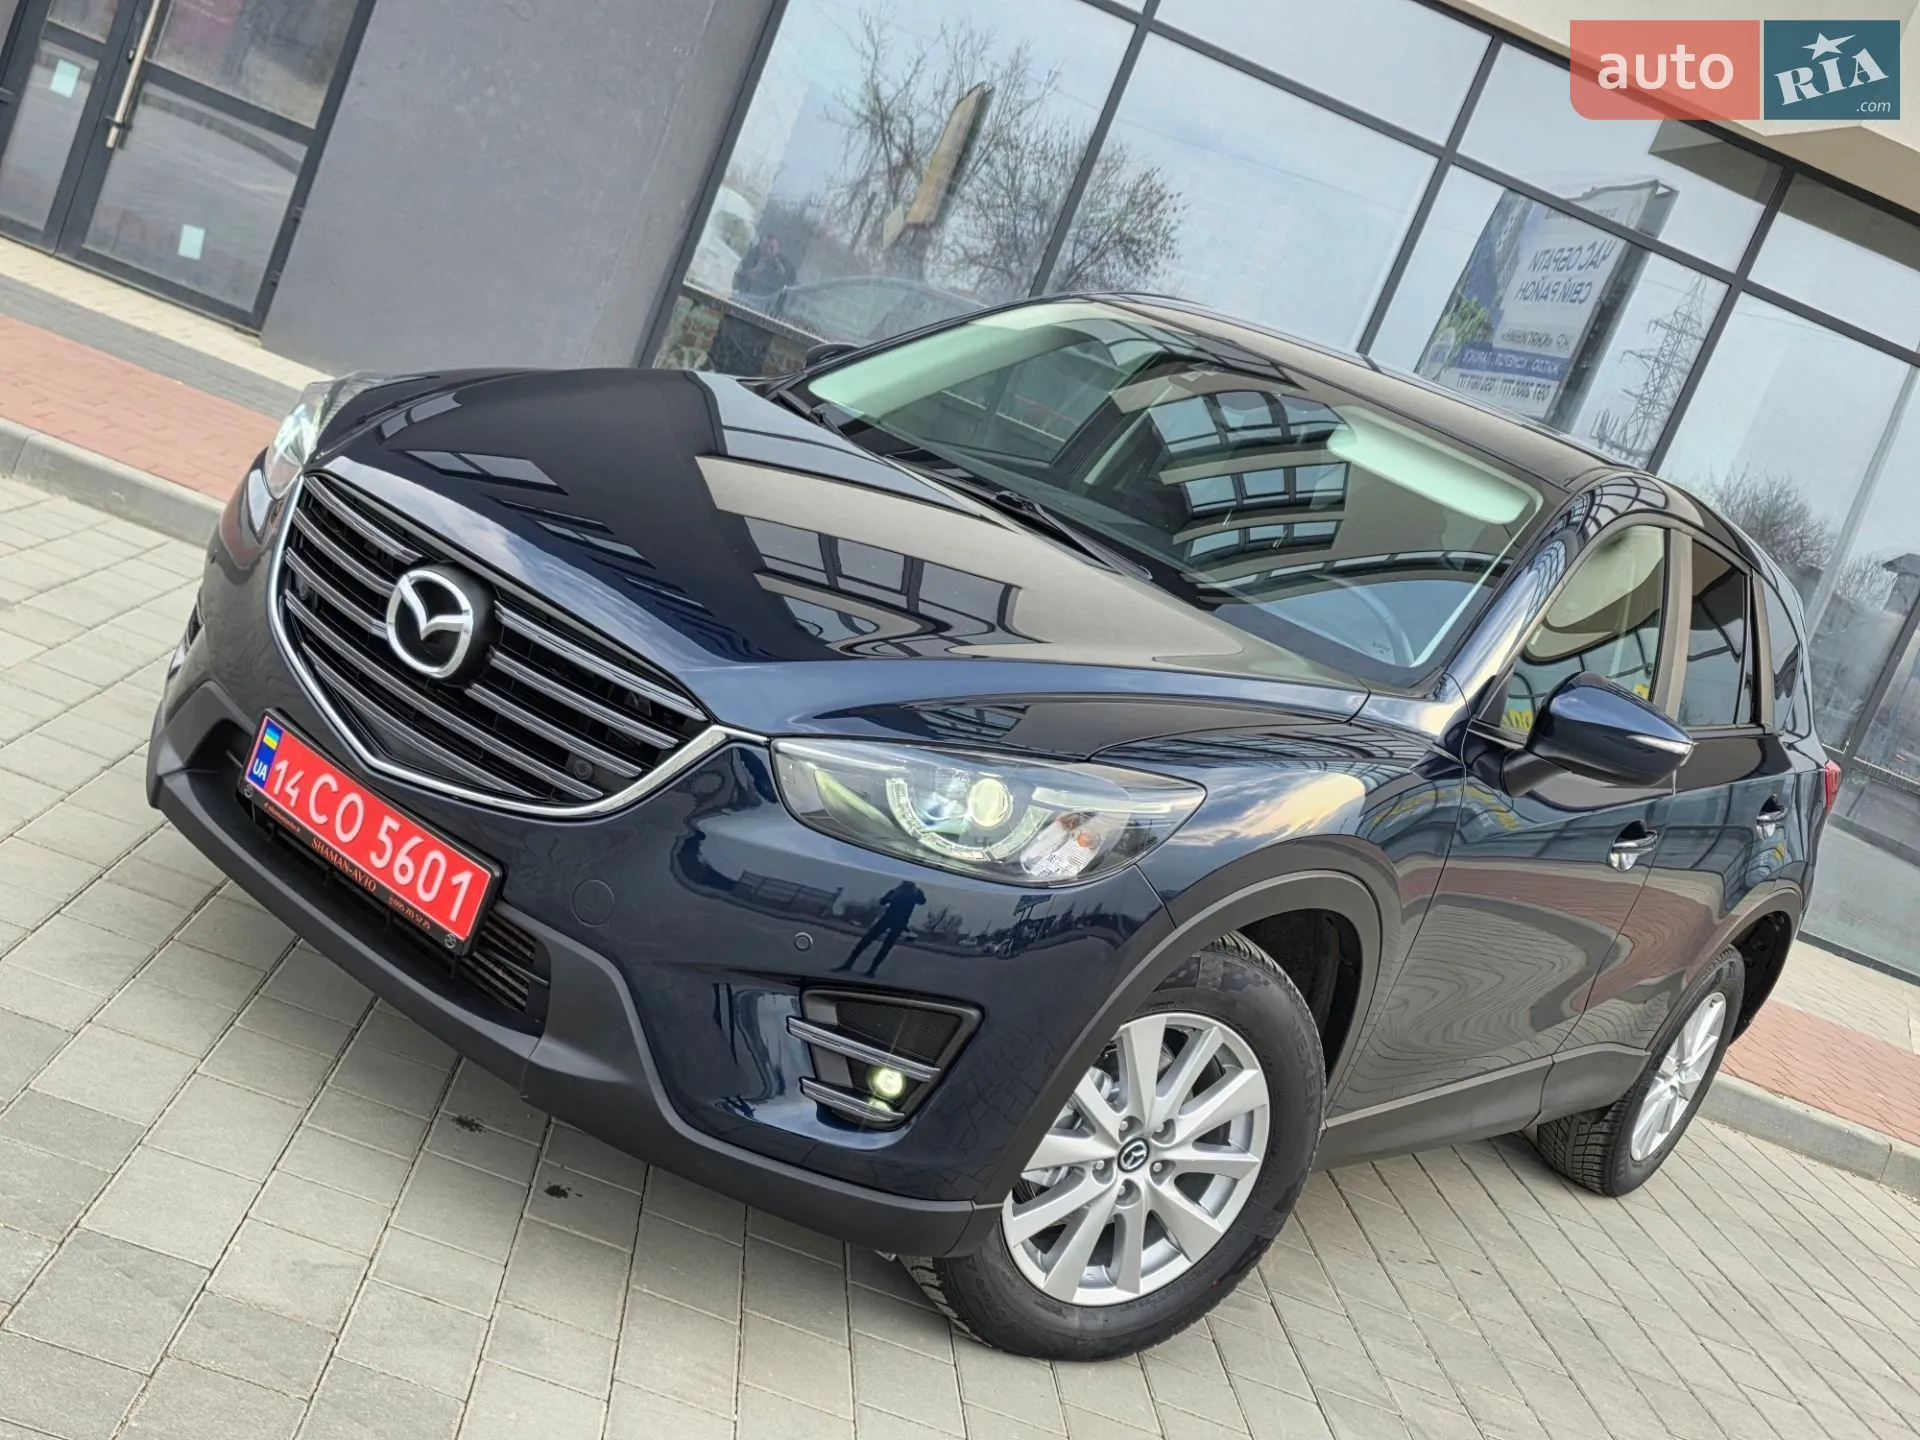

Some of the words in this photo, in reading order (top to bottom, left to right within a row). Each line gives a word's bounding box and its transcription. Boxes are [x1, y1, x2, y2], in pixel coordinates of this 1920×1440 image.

[253, 758, 267, 781] UA
[272, 759, 305, 808] 14
[309, 773, 364, 843] CO
[369, 815, 473, 922] 5601
[311, 838, 377, 893] SHAMAN-AVTO
